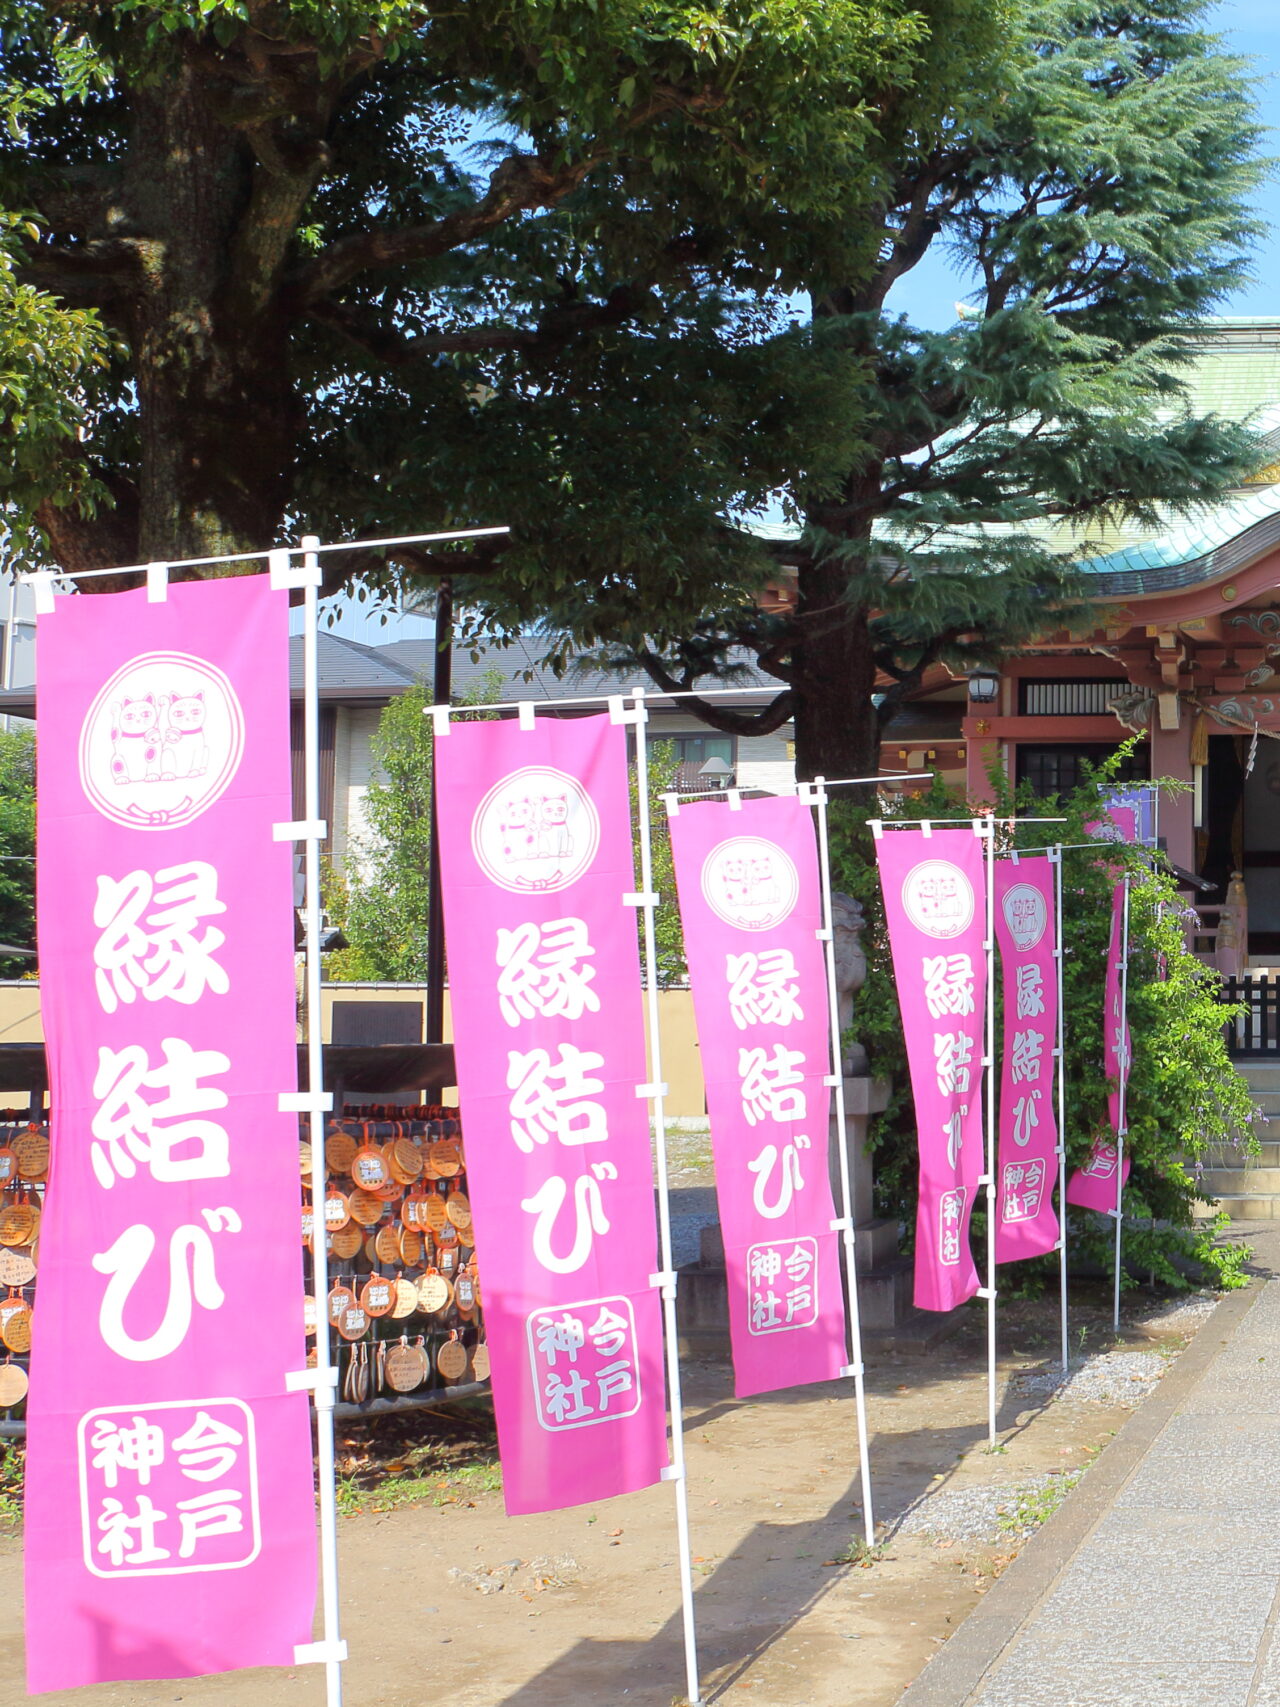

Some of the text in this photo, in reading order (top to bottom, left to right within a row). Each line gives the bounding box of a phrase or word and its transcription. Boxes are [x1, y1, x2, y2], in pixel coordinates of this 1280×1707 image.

[94, 861, 241, 1361] 縁結び
[496, 917, 617, 1274] 縁結び
[725, 949, 811, 1219] 縁結び
